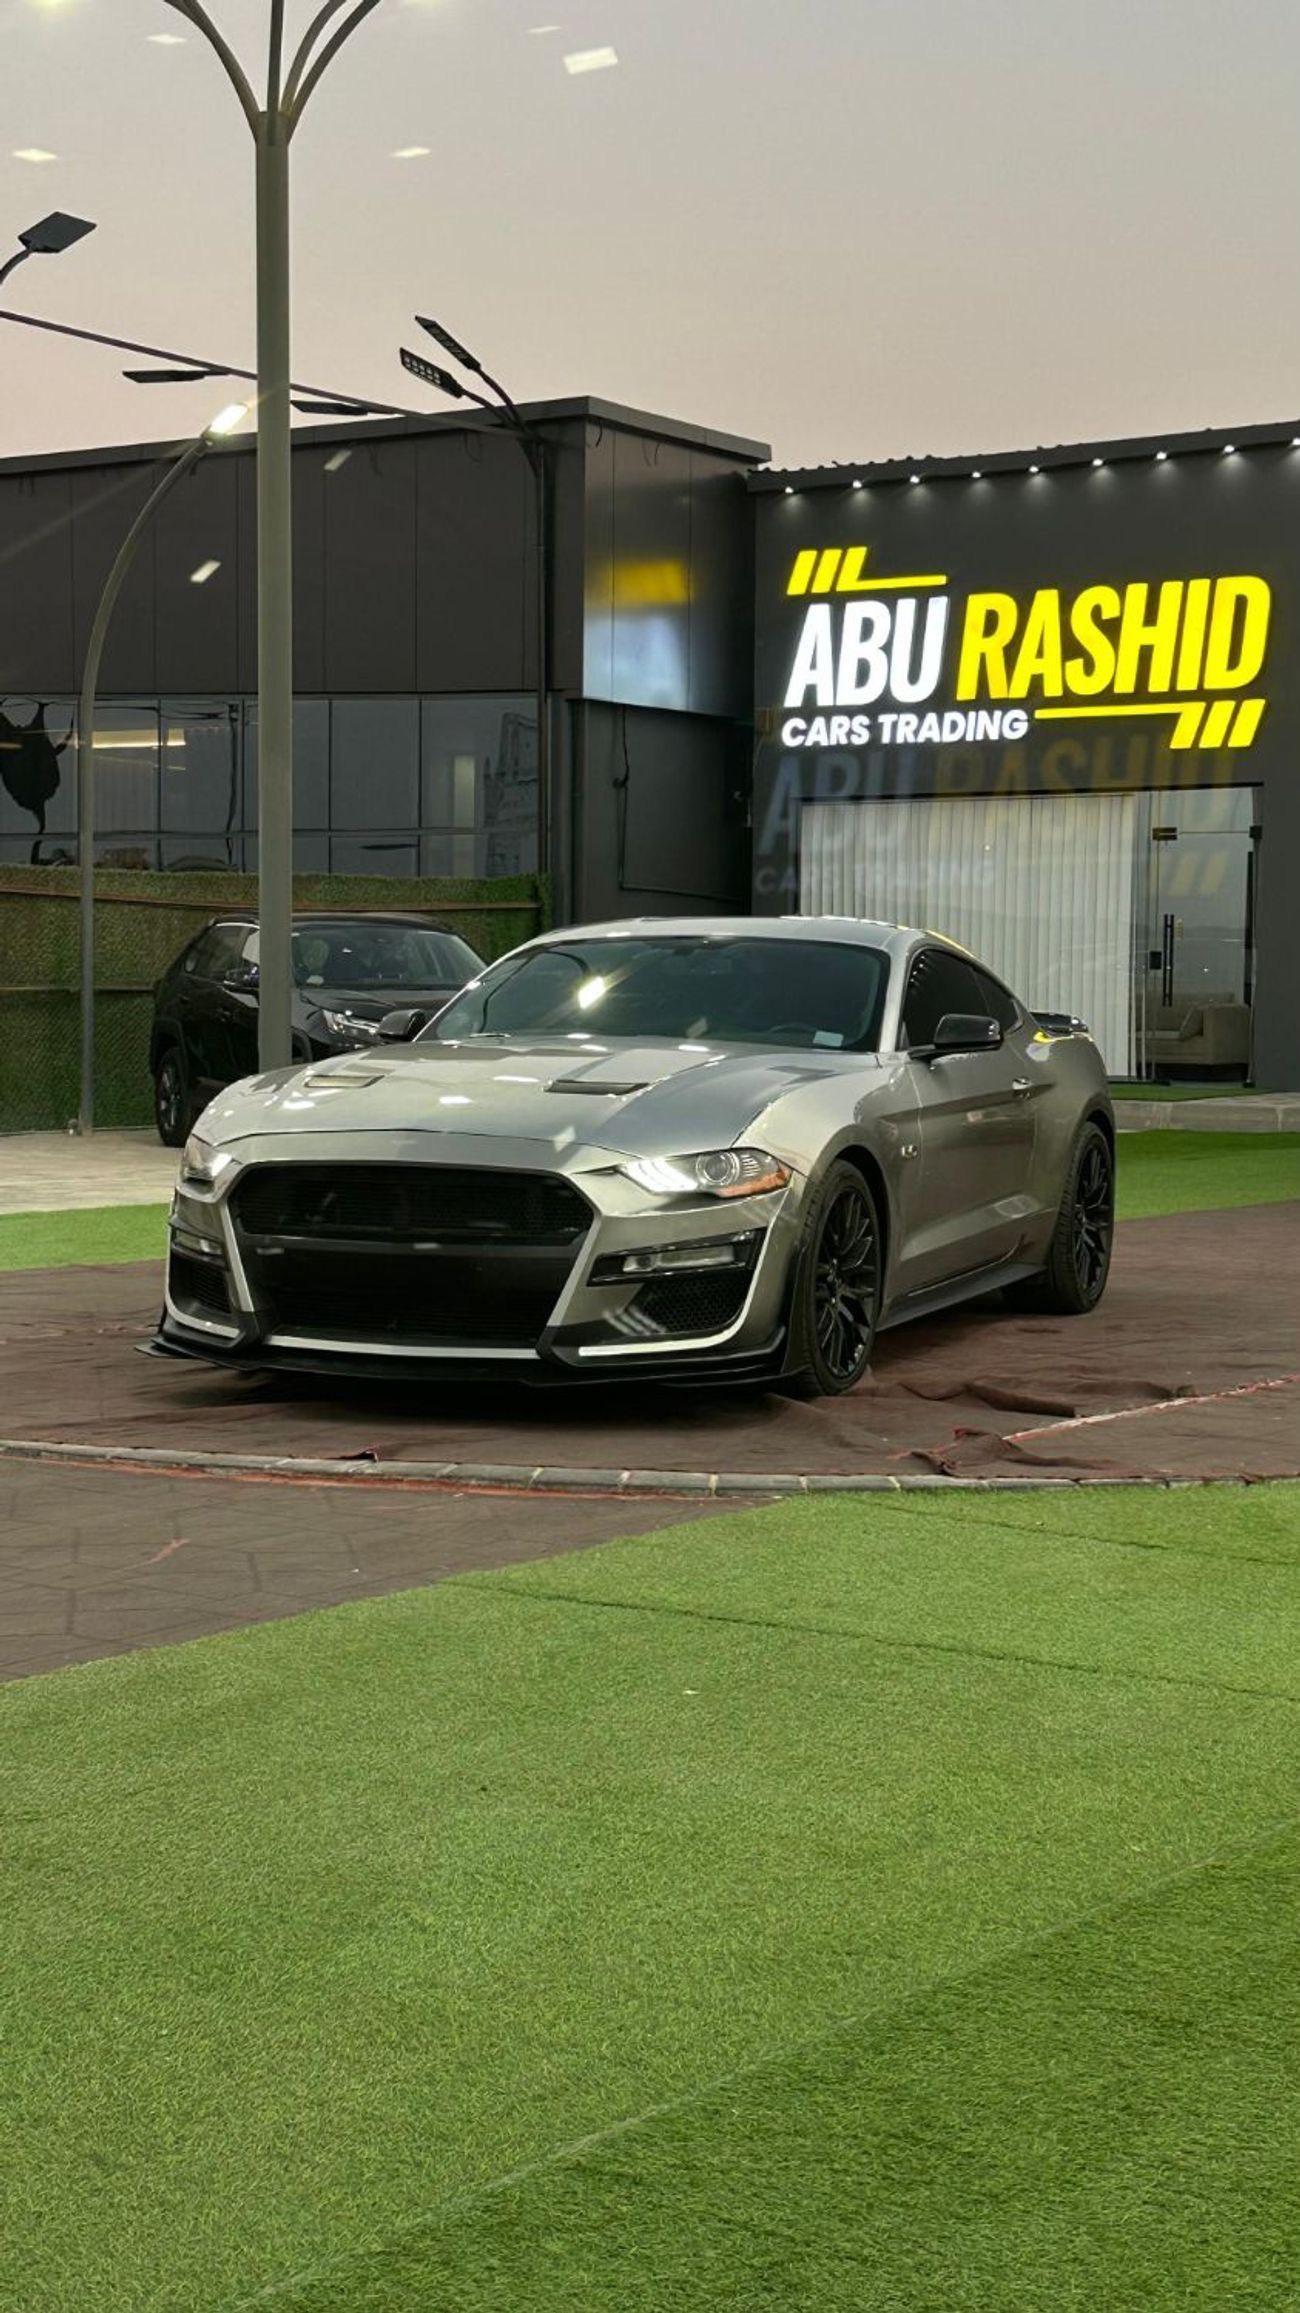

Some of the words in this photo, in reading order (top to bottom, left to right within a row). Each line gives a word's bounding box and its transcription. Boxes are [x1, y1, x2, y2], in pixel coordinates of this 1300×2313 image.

[784, 596, 949, 708] ABU
[956, 575, 1272, 701] RASHID
[781, 713, 870, 747] CARS
[877, 708, 1030, 745] TRADING
